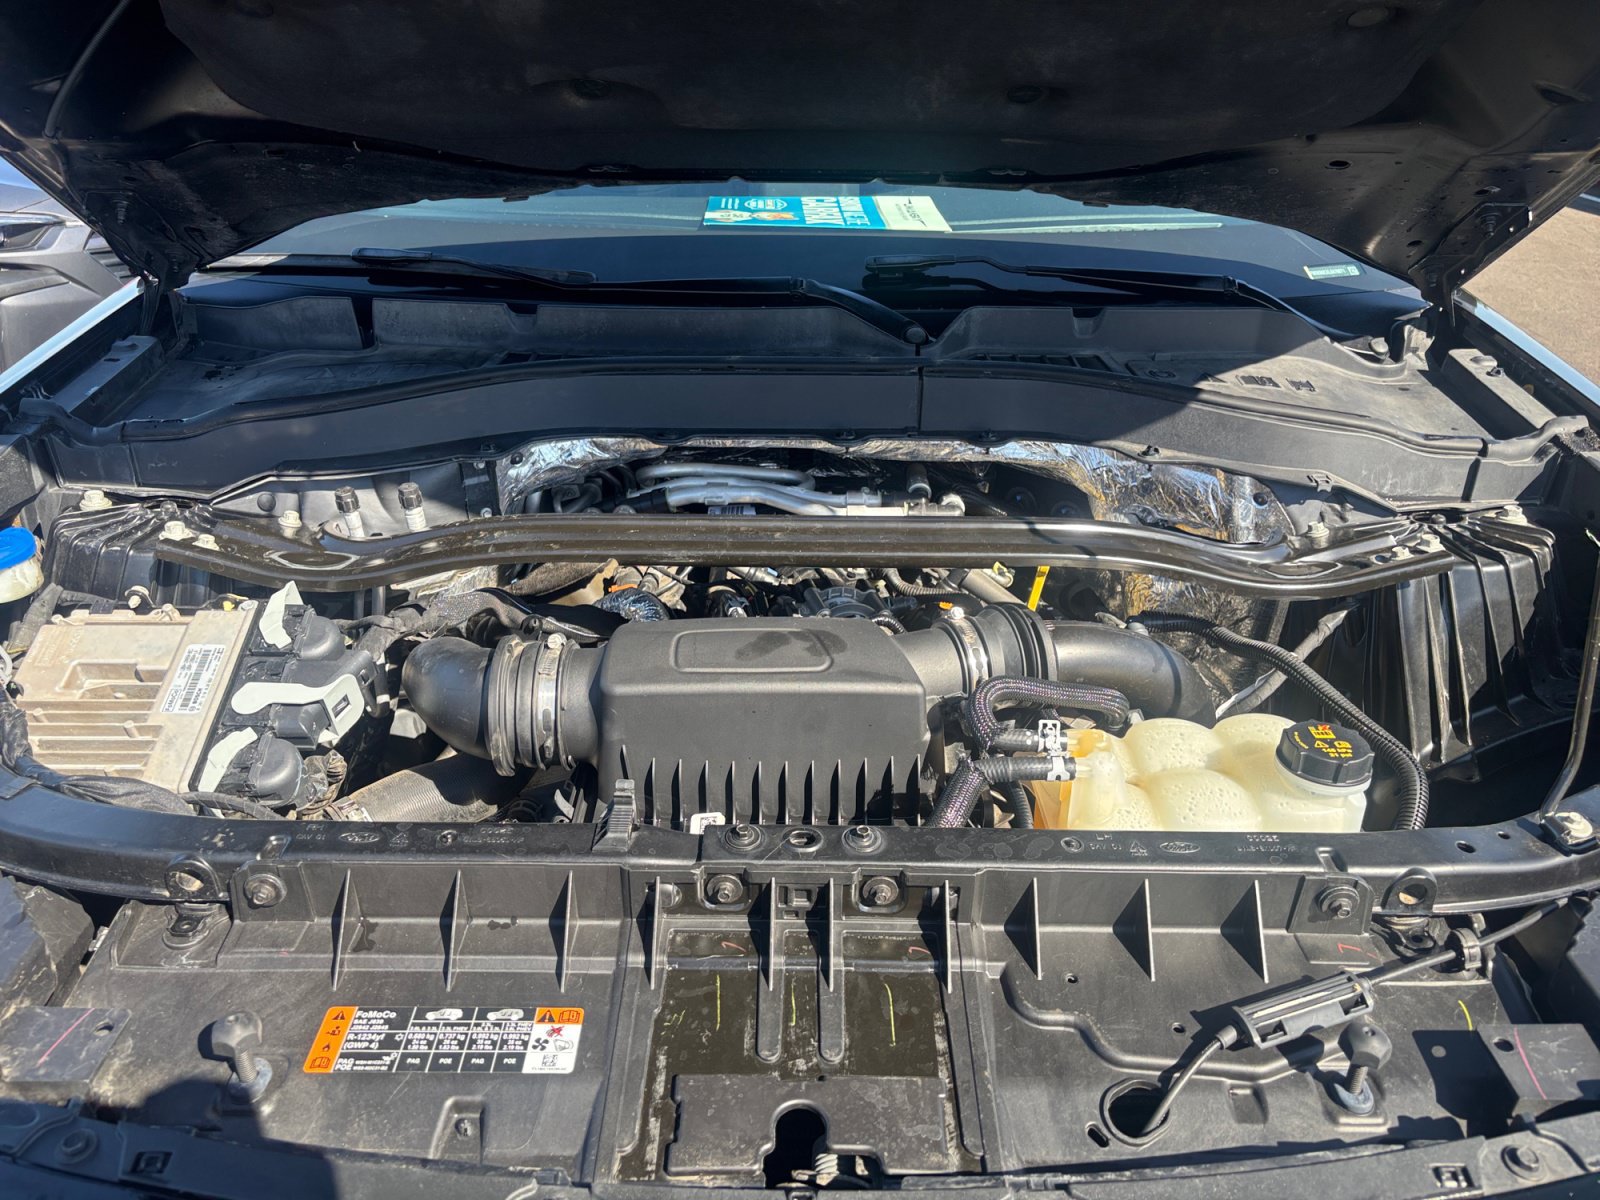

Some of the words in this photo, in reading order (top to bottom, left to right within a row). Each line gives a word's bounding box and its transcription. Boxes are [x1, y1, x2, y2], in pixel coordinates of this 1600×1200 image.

[801, 196, 845, 225] CARFAX
[355, 1010, 397, 1018] FoMoCo
[347, 1033, 386, 1041] R-1234yf
[343, 1042, 369, 1050] (GWP
[369, 1042, 379, 1050] 4)
